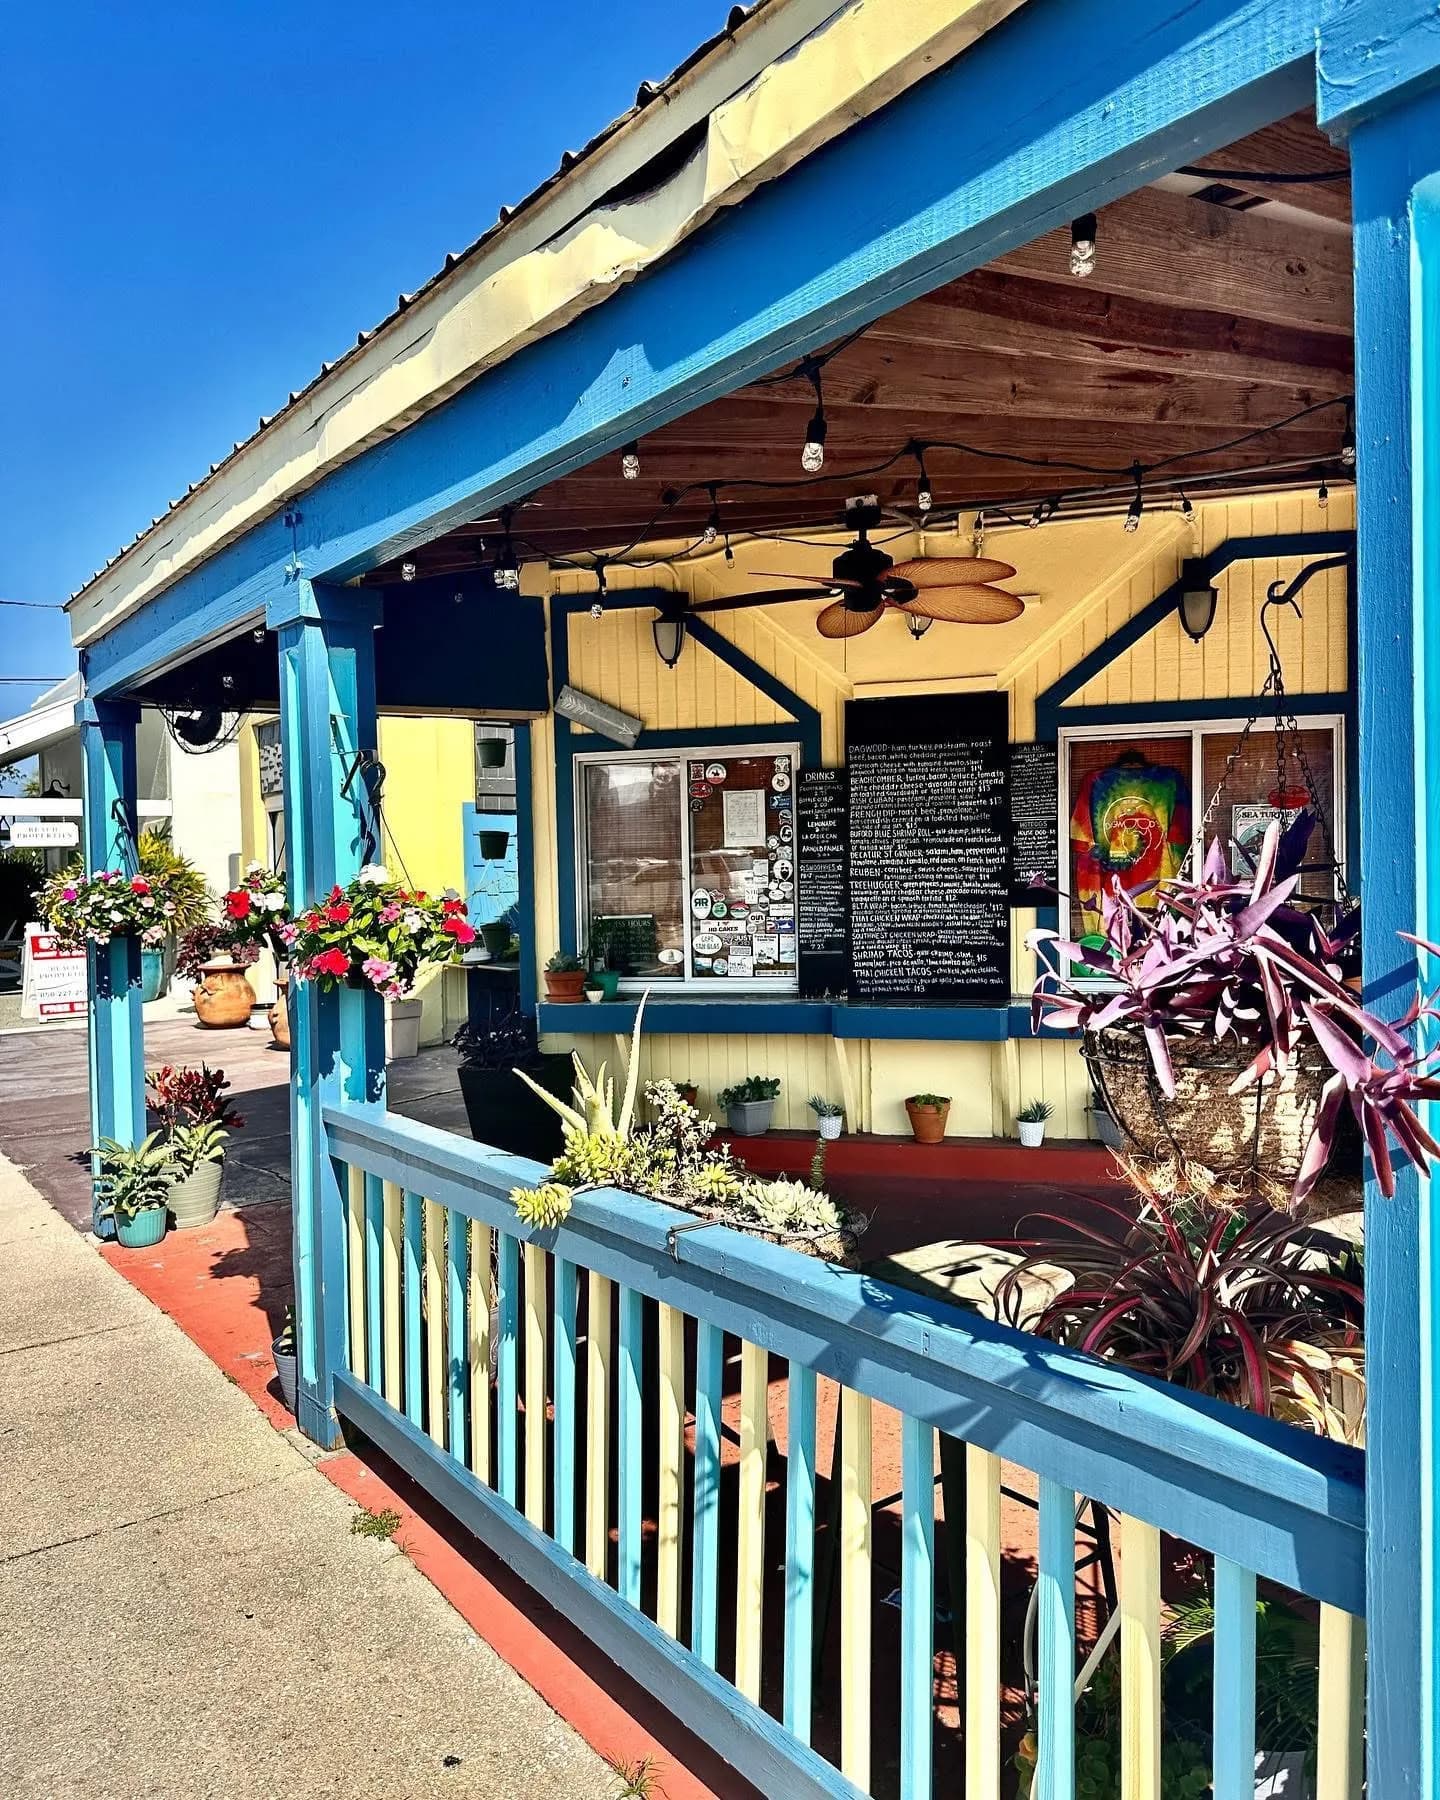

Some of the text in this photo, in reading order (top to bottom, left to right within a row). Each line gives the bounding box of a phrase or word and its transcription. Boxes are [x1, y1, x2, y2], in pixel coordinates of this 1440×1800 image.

[805, 771, 835, 782] DRINKS
[850, 809, 882, 818] FRENCH
[1241, 811, 1258, 819] SEA
[807, 820, 838, 828] LEMONADE
[874, 829, 892, 838] BLUE
[892, 828, 917, 838] SHRIMP
[870, 914, 900, 922] CHICKEN
[852, 931, 889, 940] SOUTHWEST
[889, 930, 917, 939] CHICKEN
[852, 950, 885, 960] SHRIMP
[976, 953, 988, 962] $15
[852, 969, 873, 978] THAI
[874, 968, 904, 978] CHICKEN
